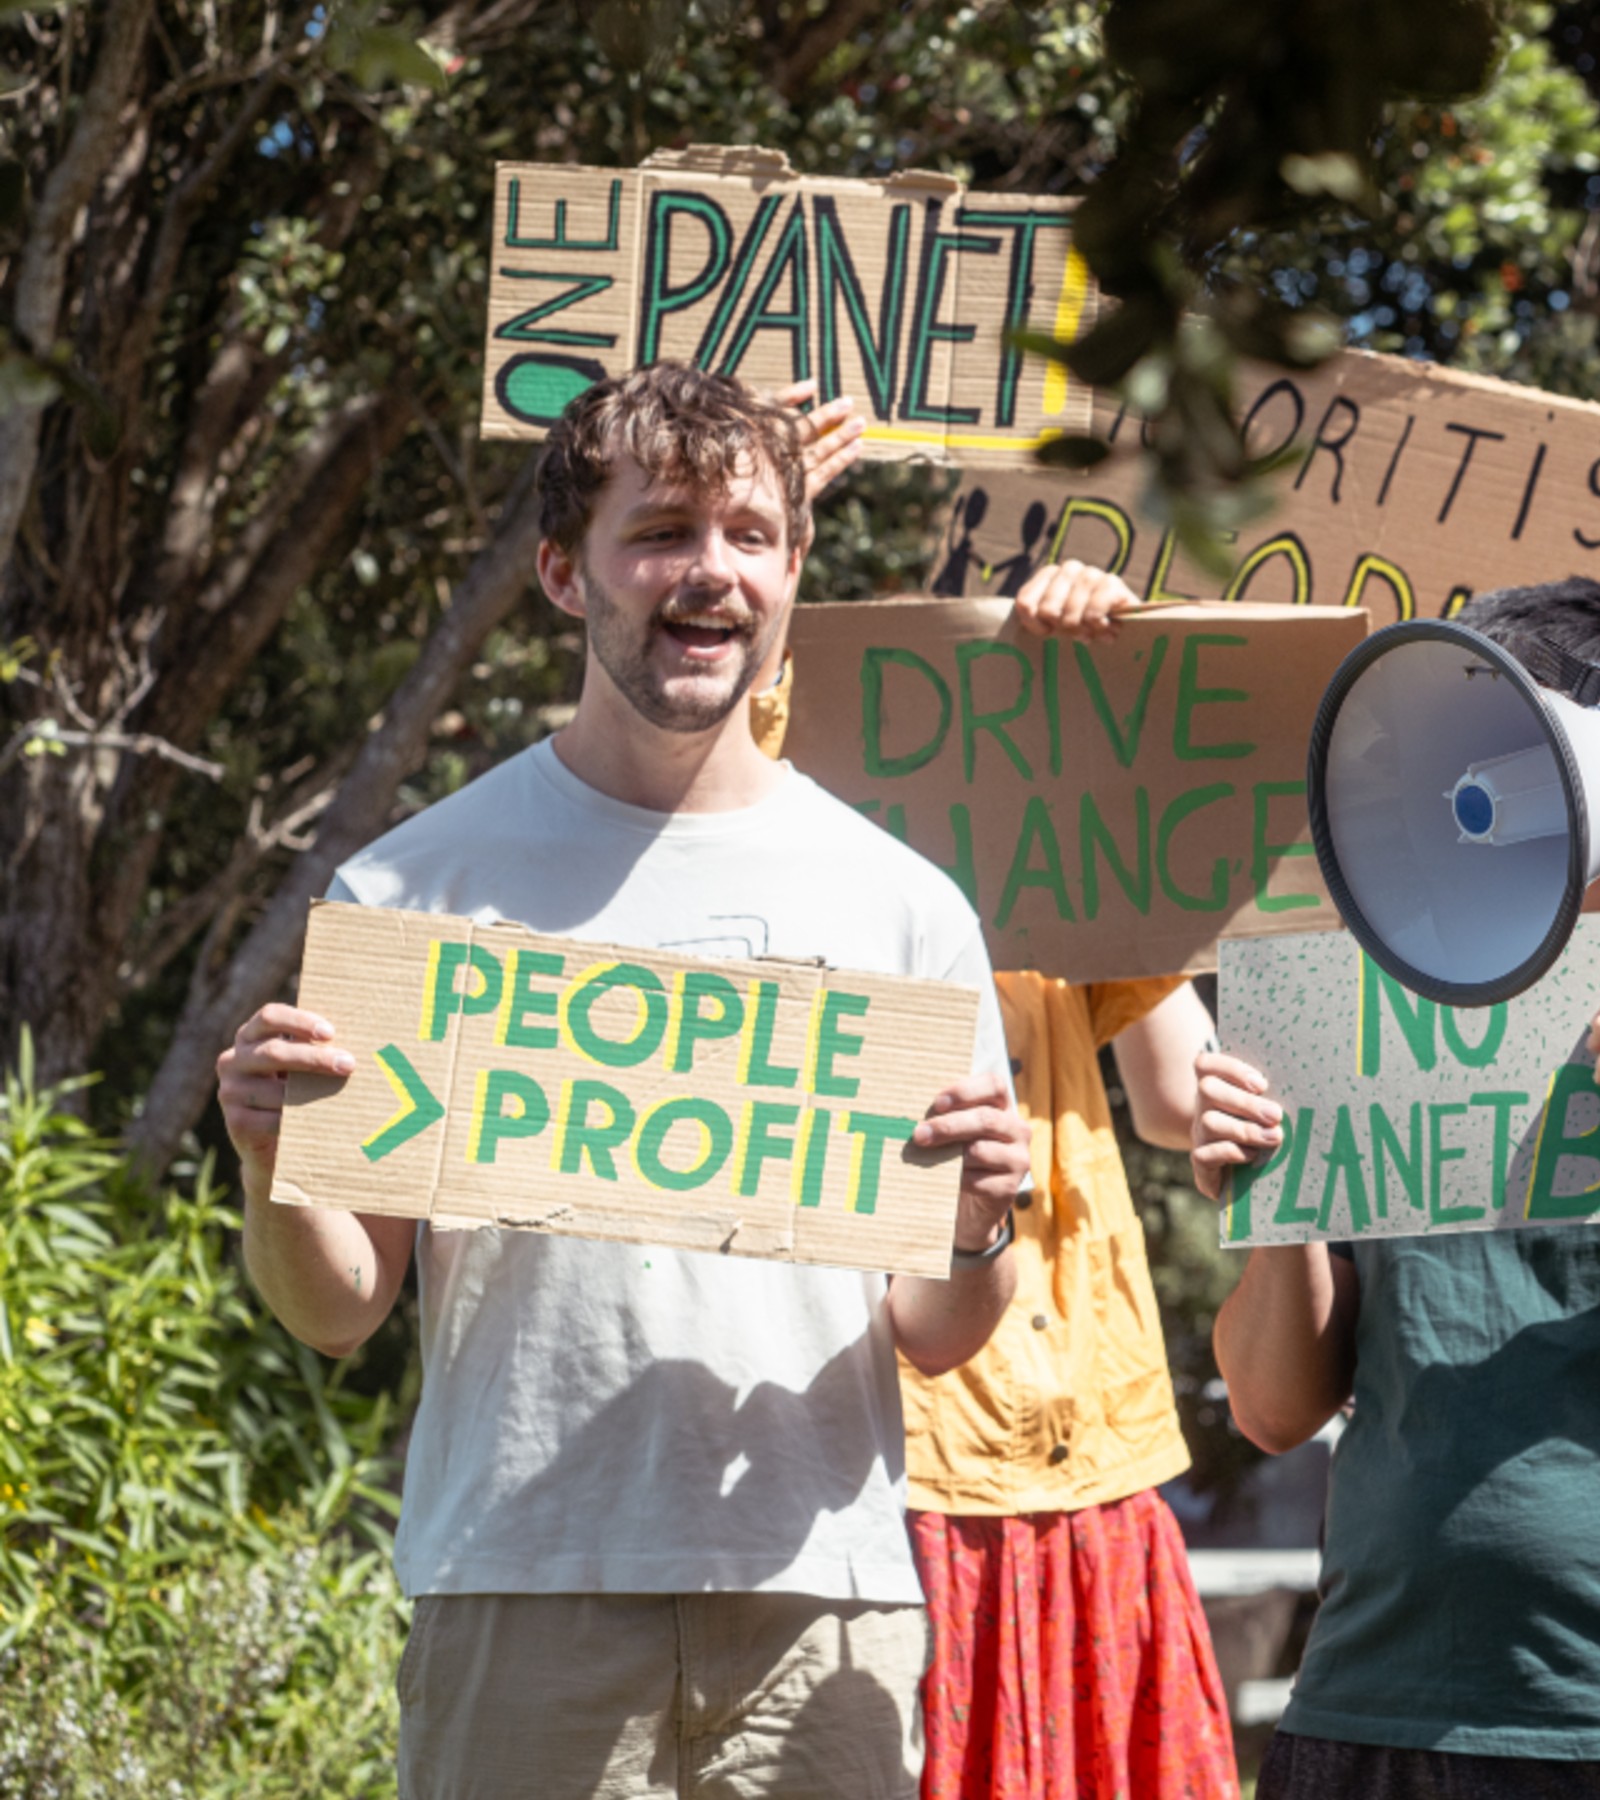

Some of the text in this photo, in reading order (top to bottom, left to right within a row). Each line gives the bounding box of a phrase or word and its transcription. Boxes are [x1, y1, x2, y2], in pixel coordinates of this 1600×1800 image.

[494, 175, 621, 427] ONE
[860, 631, 1258, 784] DRIVE
[417, 939, 871, 1098] PEOPLE
[1356, 946, 1509, 1078] NO
[465, 1068, 918, 1215] PROFIT
[1227, 1089, 1530, 1241] PLANET
